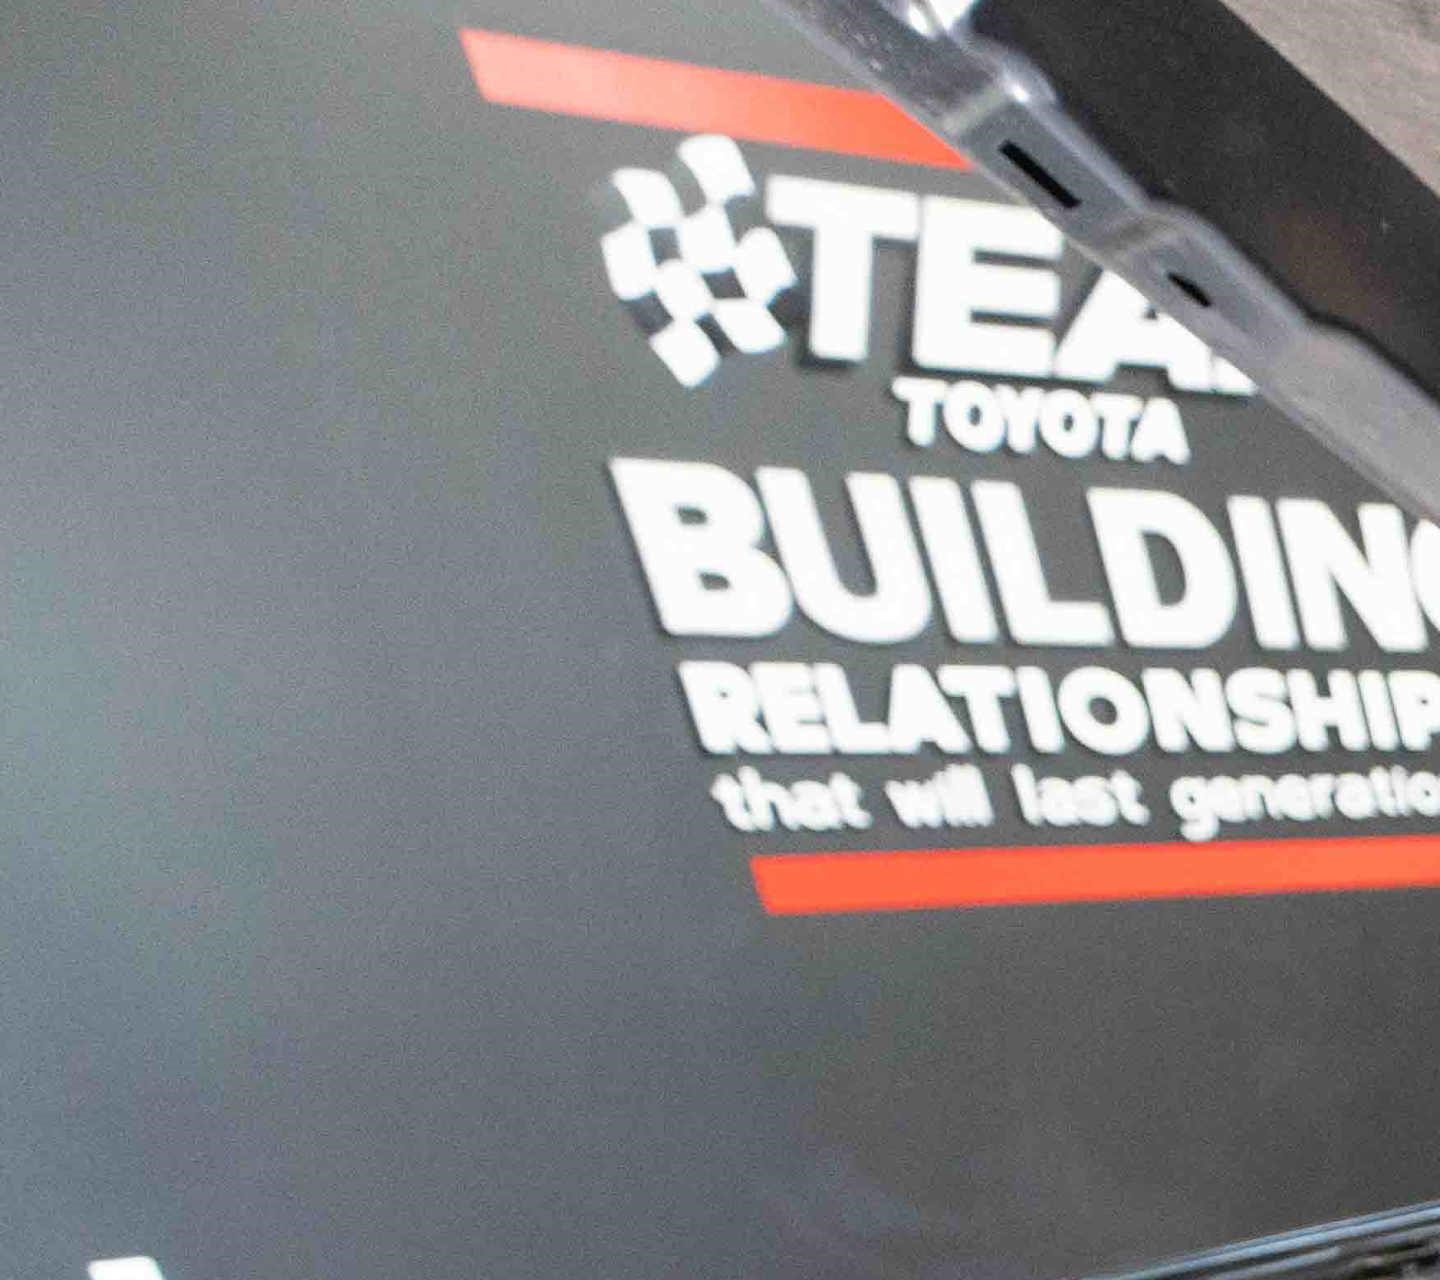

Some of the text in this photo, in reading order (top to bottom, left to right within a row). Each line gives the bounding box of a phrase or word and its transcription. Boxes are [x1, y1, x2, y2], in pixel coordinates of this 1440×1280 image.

[766, 174, 1256, 396] TEA
[892, 376, 1191, 464] TOYOTA
[710, 765, 873, 831] that
[885, 763, 995, 828] will
[1011, 763, 1150, 827] last
